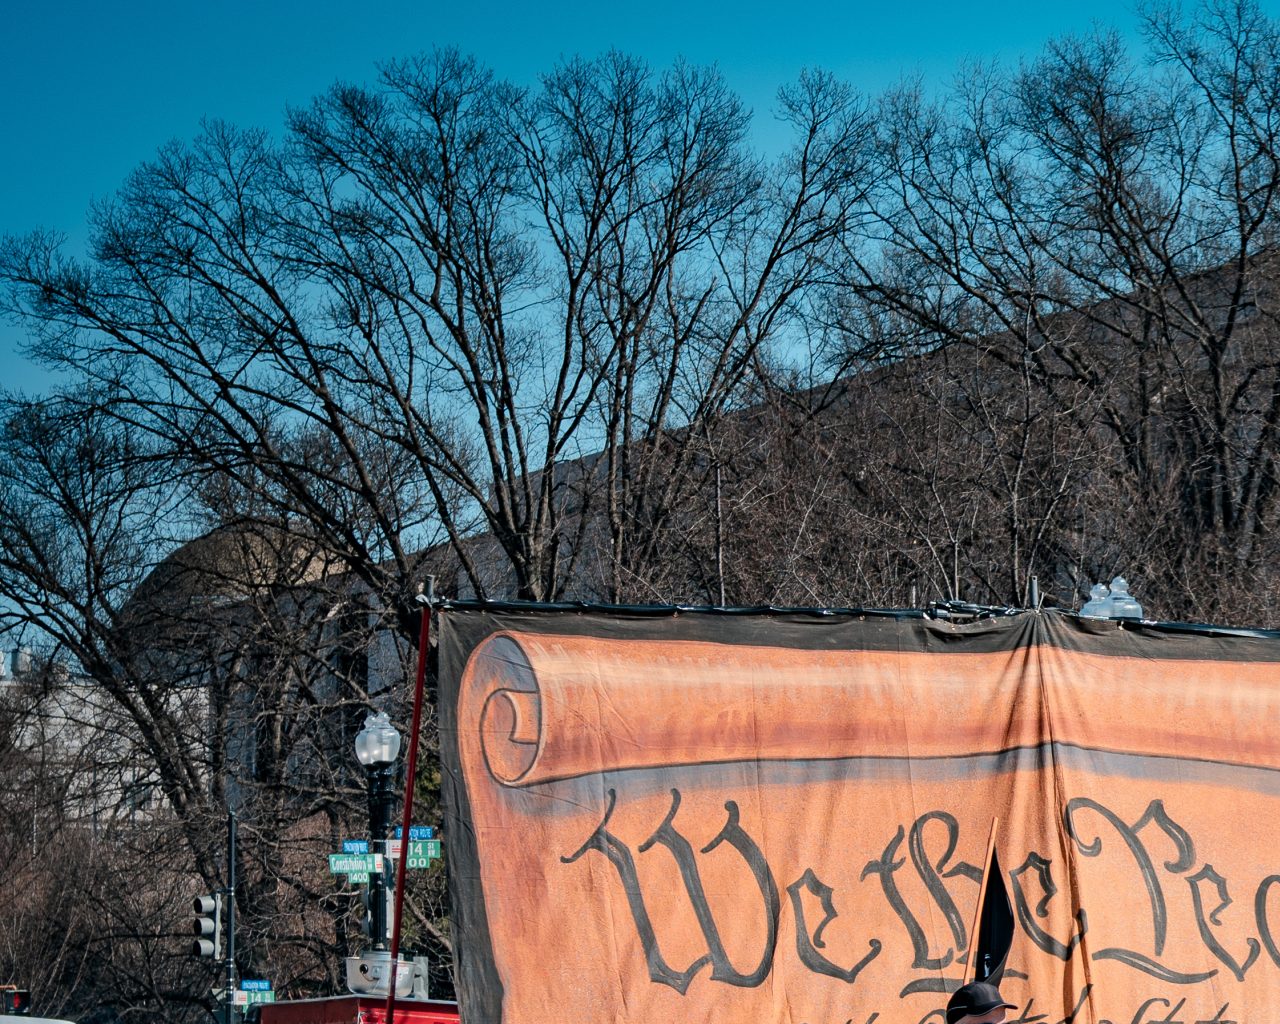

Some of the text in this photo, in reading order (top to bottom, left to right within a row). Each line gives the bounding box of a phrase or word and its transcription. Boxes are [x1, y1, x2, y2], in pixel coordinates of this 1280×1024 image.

[409, 843, 422, 856] 14
[331, 857, 367, 871] Constitution
[350, 873, 368, 882] 1400
[559, 787, 882, 996] We
[860, 810, 1087, 998] the
